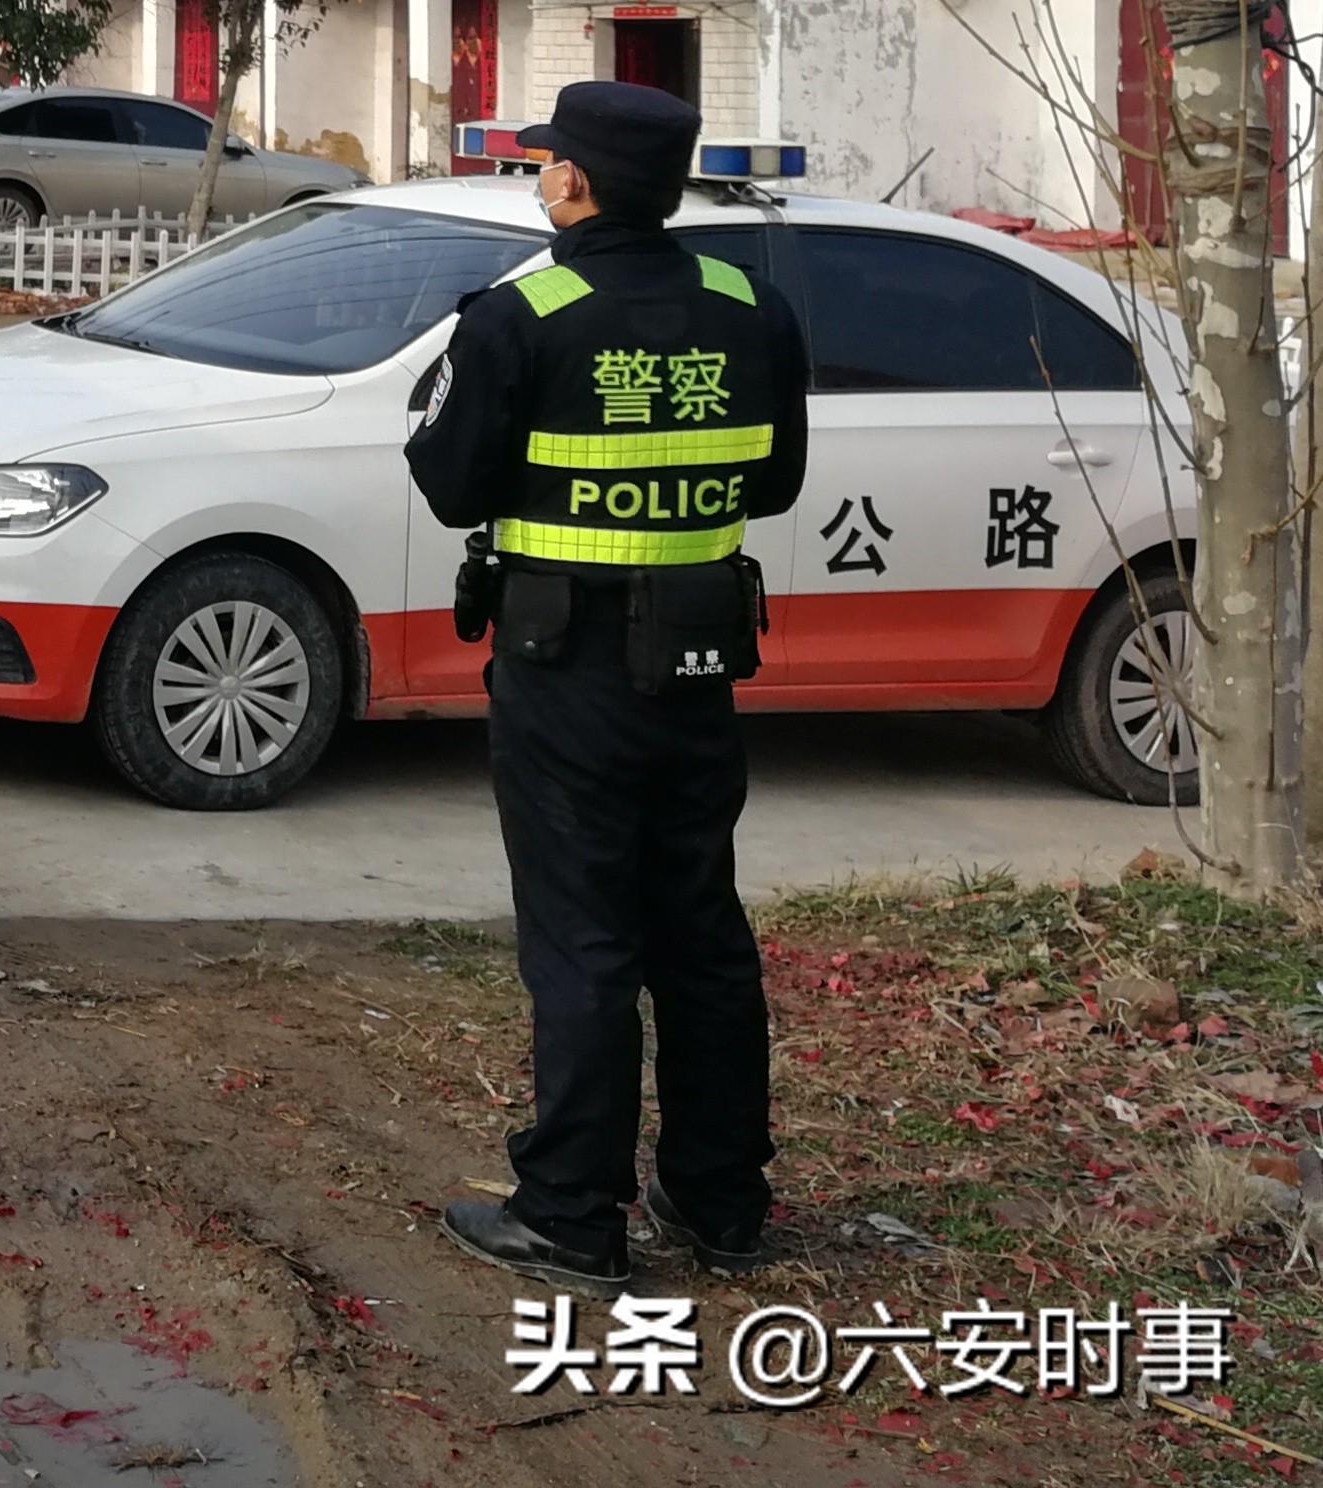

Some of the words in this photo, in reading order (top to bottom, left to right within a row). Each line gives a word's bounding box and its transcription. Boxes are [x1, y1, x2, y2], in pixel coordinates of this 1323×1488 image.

[594, 348, 731, 425] 警察
[570, 475, 745, 519] POLICE
[676, 663, 725, 676] POLICE
